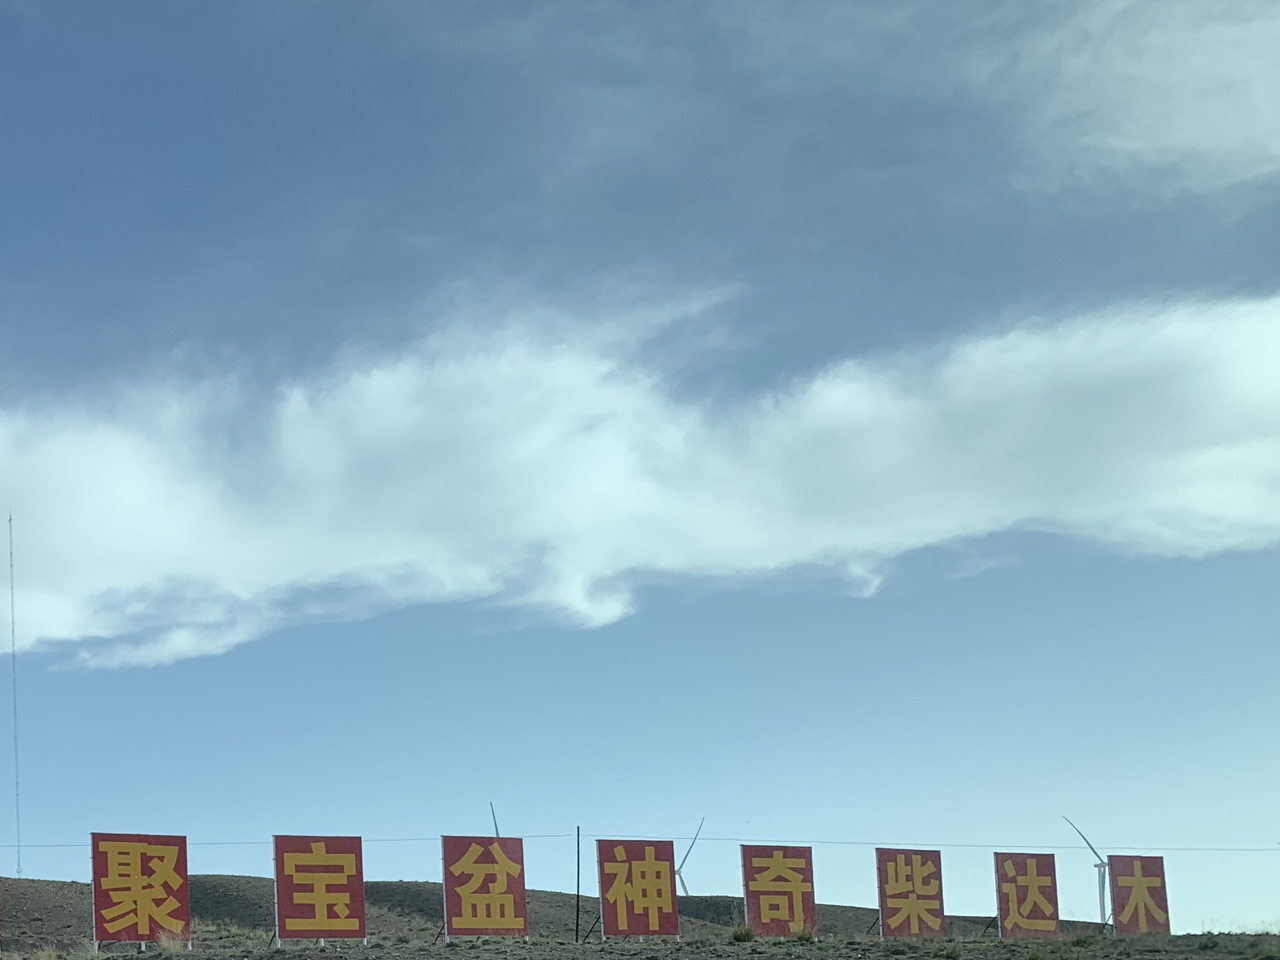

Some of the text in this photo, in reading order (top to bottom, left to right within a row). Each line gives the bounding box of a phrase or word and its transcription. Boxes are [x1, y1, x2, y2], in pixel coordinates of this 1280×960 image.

[99, 841, 186, 935] 聚
[284, 842, 359, 930] 宝
[449, 842, 524, 930] 盆
[604, 845, 674, 931] 神
[749, 851, 812, 933] 奇
[885, 854, 941, 932] 柴
[1004, 859, 1056, 931] 达
[1117, 859, 1166, 931] 木
